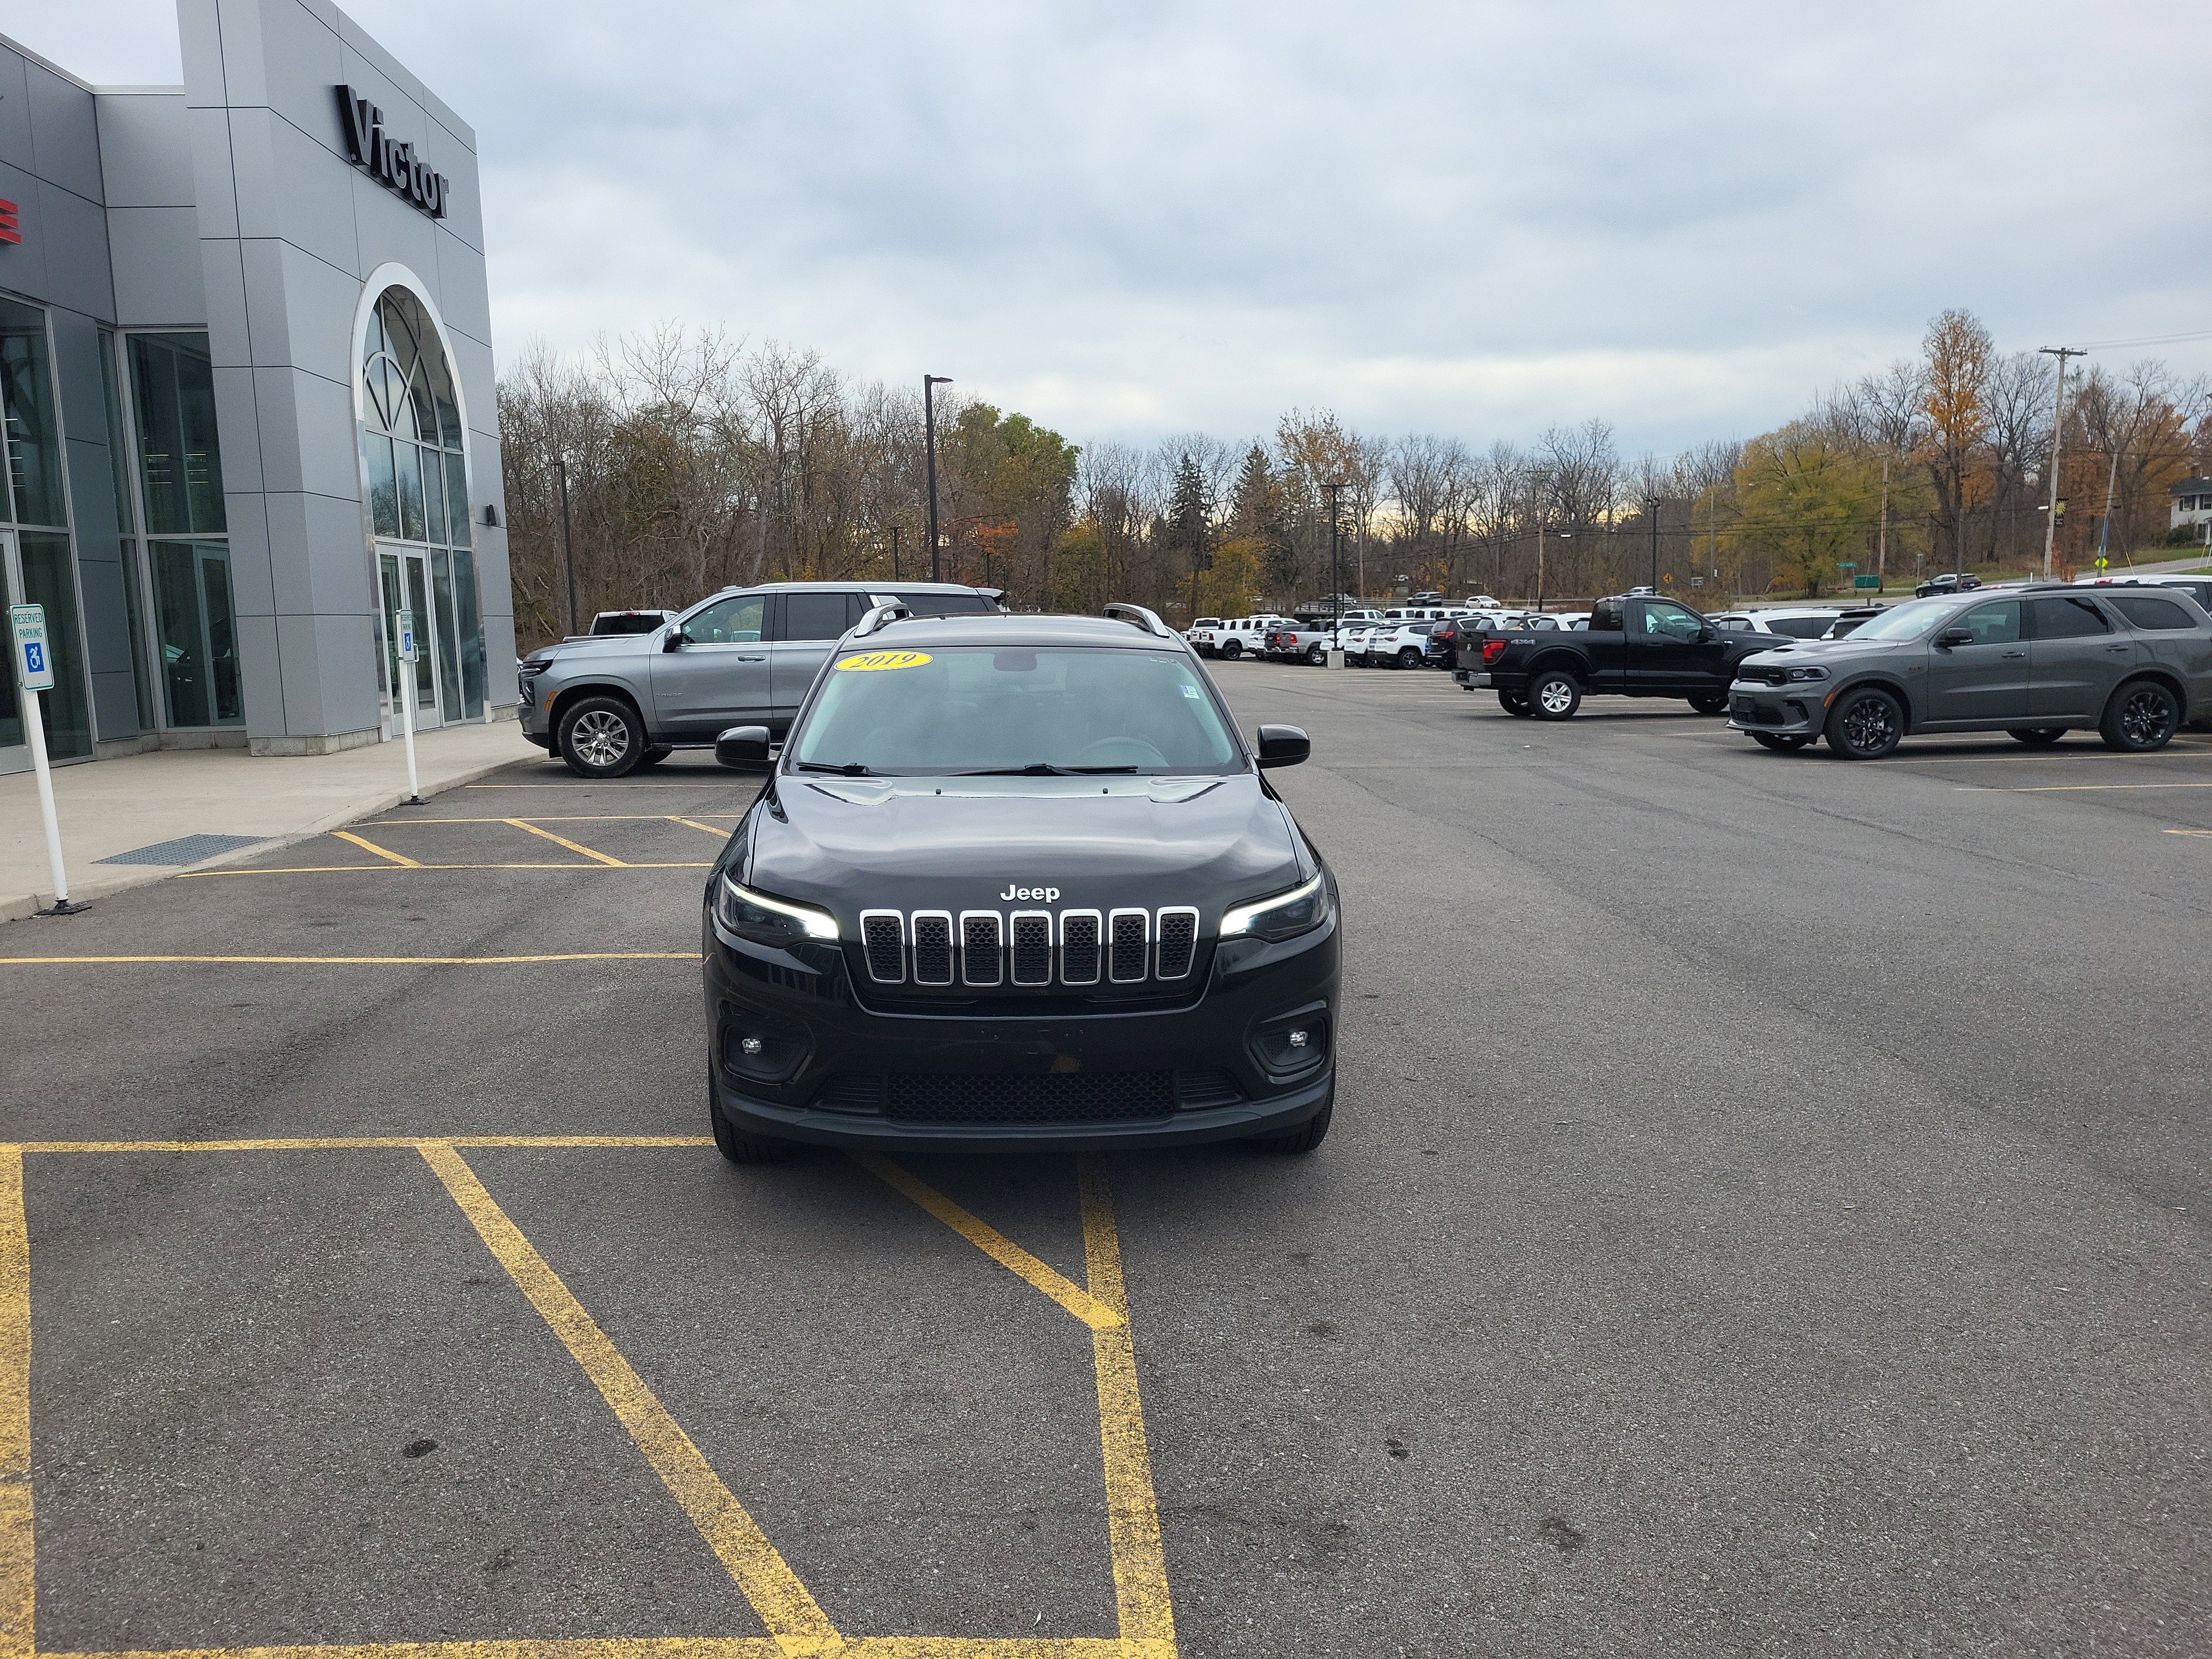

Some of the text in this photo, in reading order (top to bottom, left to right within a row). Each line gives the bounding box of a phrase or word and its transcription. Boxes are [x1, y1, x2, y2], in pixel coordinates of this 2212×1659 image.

[334, 84, 449, 218] Victor
[14, 613, 43, 624] RESERVED
[19, 628, 42, 639] PARKING
[849, 654, 917, 668] 2019
[1000, 884, 1060, 904] Jeep
